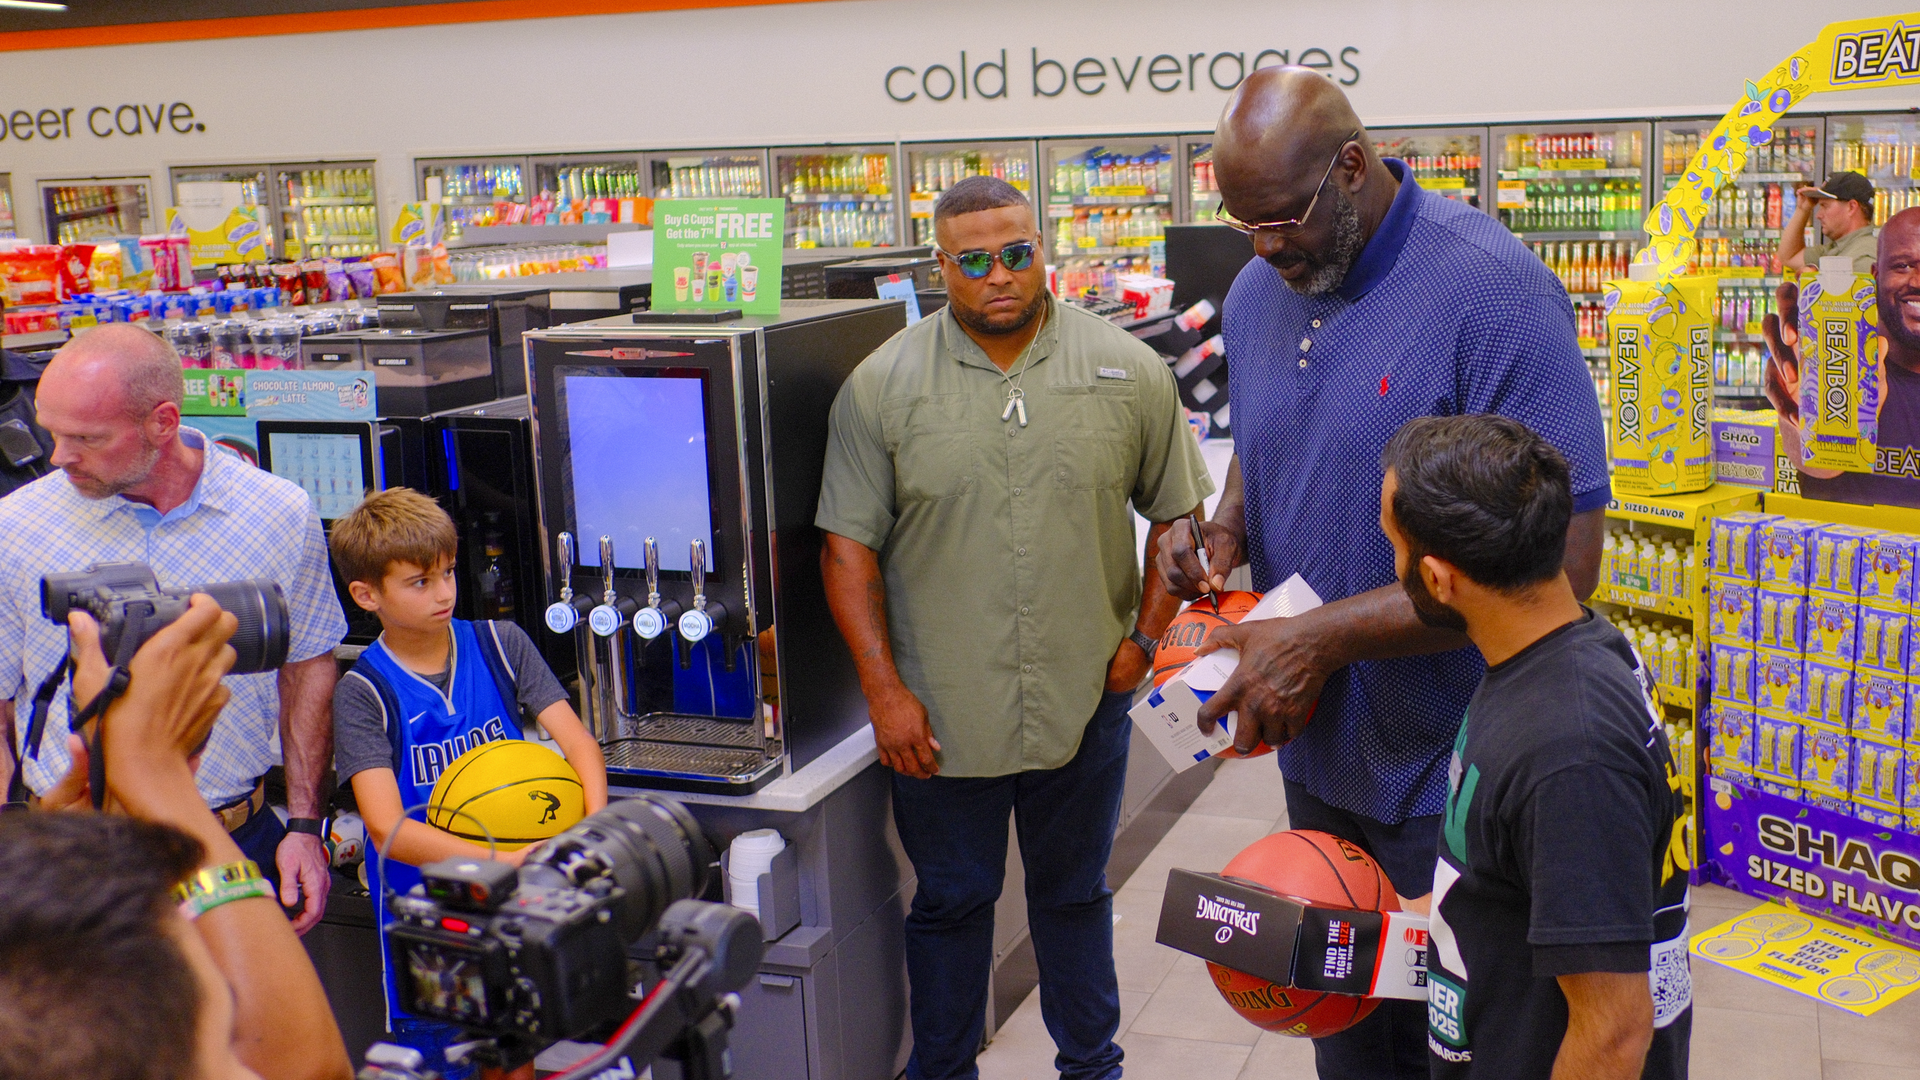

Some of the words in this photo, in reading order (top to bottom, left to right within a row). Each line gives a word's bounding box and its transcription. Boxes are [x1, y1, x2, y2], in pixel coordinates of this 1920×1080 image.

[884, 48, 1008, 103] cold
[87, 102, 206, 138] cave.
[664, 214, 682, 227] Buy
[682, 213, 690, 225] 6
[690, 213, 714, 227] Cups
[715, 212, 773, 239] FREE
[666, 228, 683, 239] Get
[684, 228, 700, 239] the
[701, 227, 714, 239] 7TH
[1825, 319, 1849, 424] BEATBOX
[253, 381, 298, 391] CHOCOLATE
[302, 381, 335, 391] ALMOND
[1617, 326, 1641, 443] BEATBOX
[281, 393, 307, 404] LATTE
[1721, 432, 1760, 445] SHAQ
[1717, 461, 1765, 481] BEATBOX
[1874, 449, 1920, 476] BEA
[1624, 502, 1649, 514] SIZED
[1650, 507, 1685, 519] FLAVOR
[1610, 589, 1636, 604] 11.1%
[1638, 595, 1656, 607] ABV
[1758, 814, 1920, 894] SHAQ
[1748, 854, 1828, 899] SIZED
[1196, 894, 1260, 936] SPALDING
[1327, 919, 1341, 944] THE
[1339, 921, 1350, 945] SIZE
[1820, 928, 1876, 949] SHAQ
[1793, 951, 1826, 965] BIG
[1798, 944, 1840, 961] INTO
[1808, 939, 1850, 955] STEP
[1324, 948, 1338, 978] FIND
[1335, 947, 1348, 979] RIGHT
[1766, 950, 1831, 976] FLAVOR
[1428, 1006, 1460, 1040] 025
